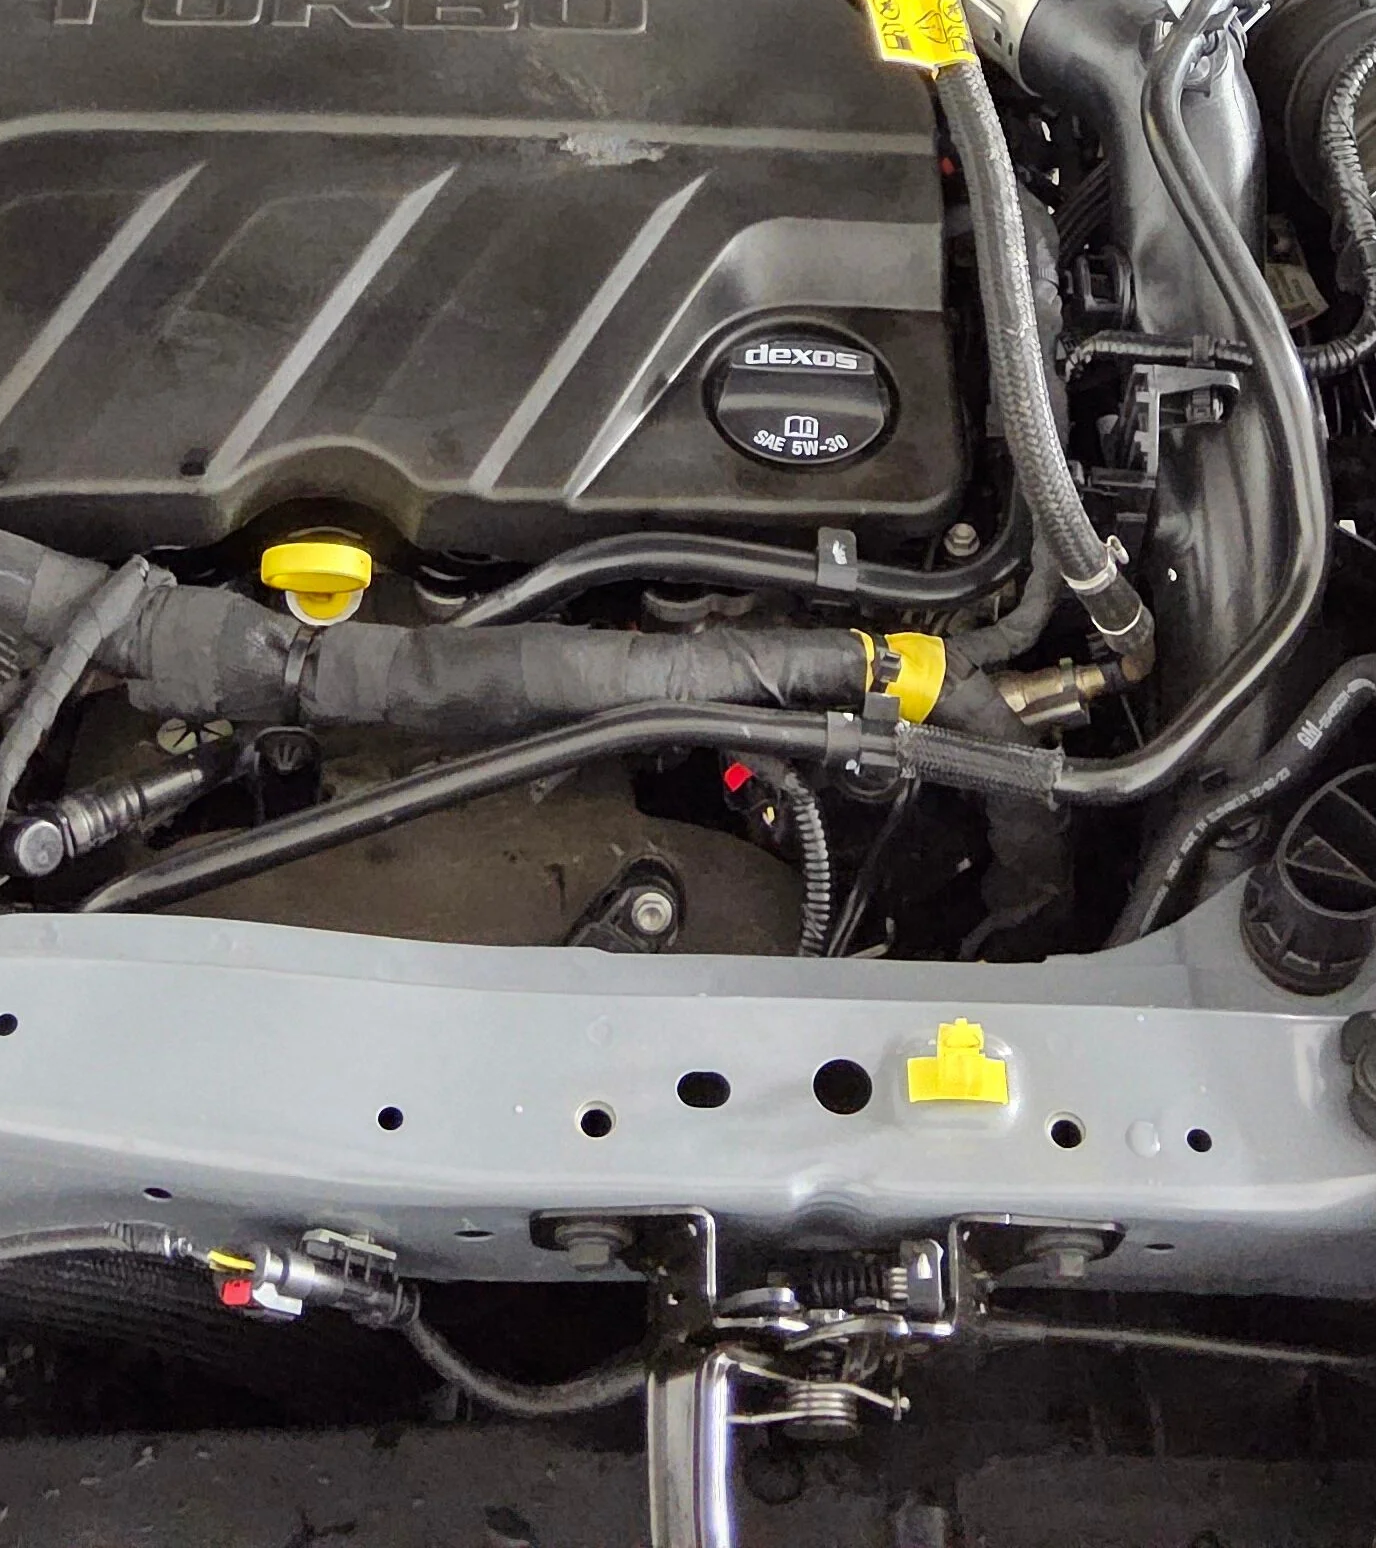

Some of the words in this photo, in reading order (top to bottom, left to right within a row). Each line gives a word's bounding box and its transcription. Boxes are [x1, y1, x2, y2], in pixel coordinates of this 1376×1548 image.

[744, 343, 859, 371] dexos
[753, 429, 787, 453] SAE
[791, 434, 850, 456] 5W-30
